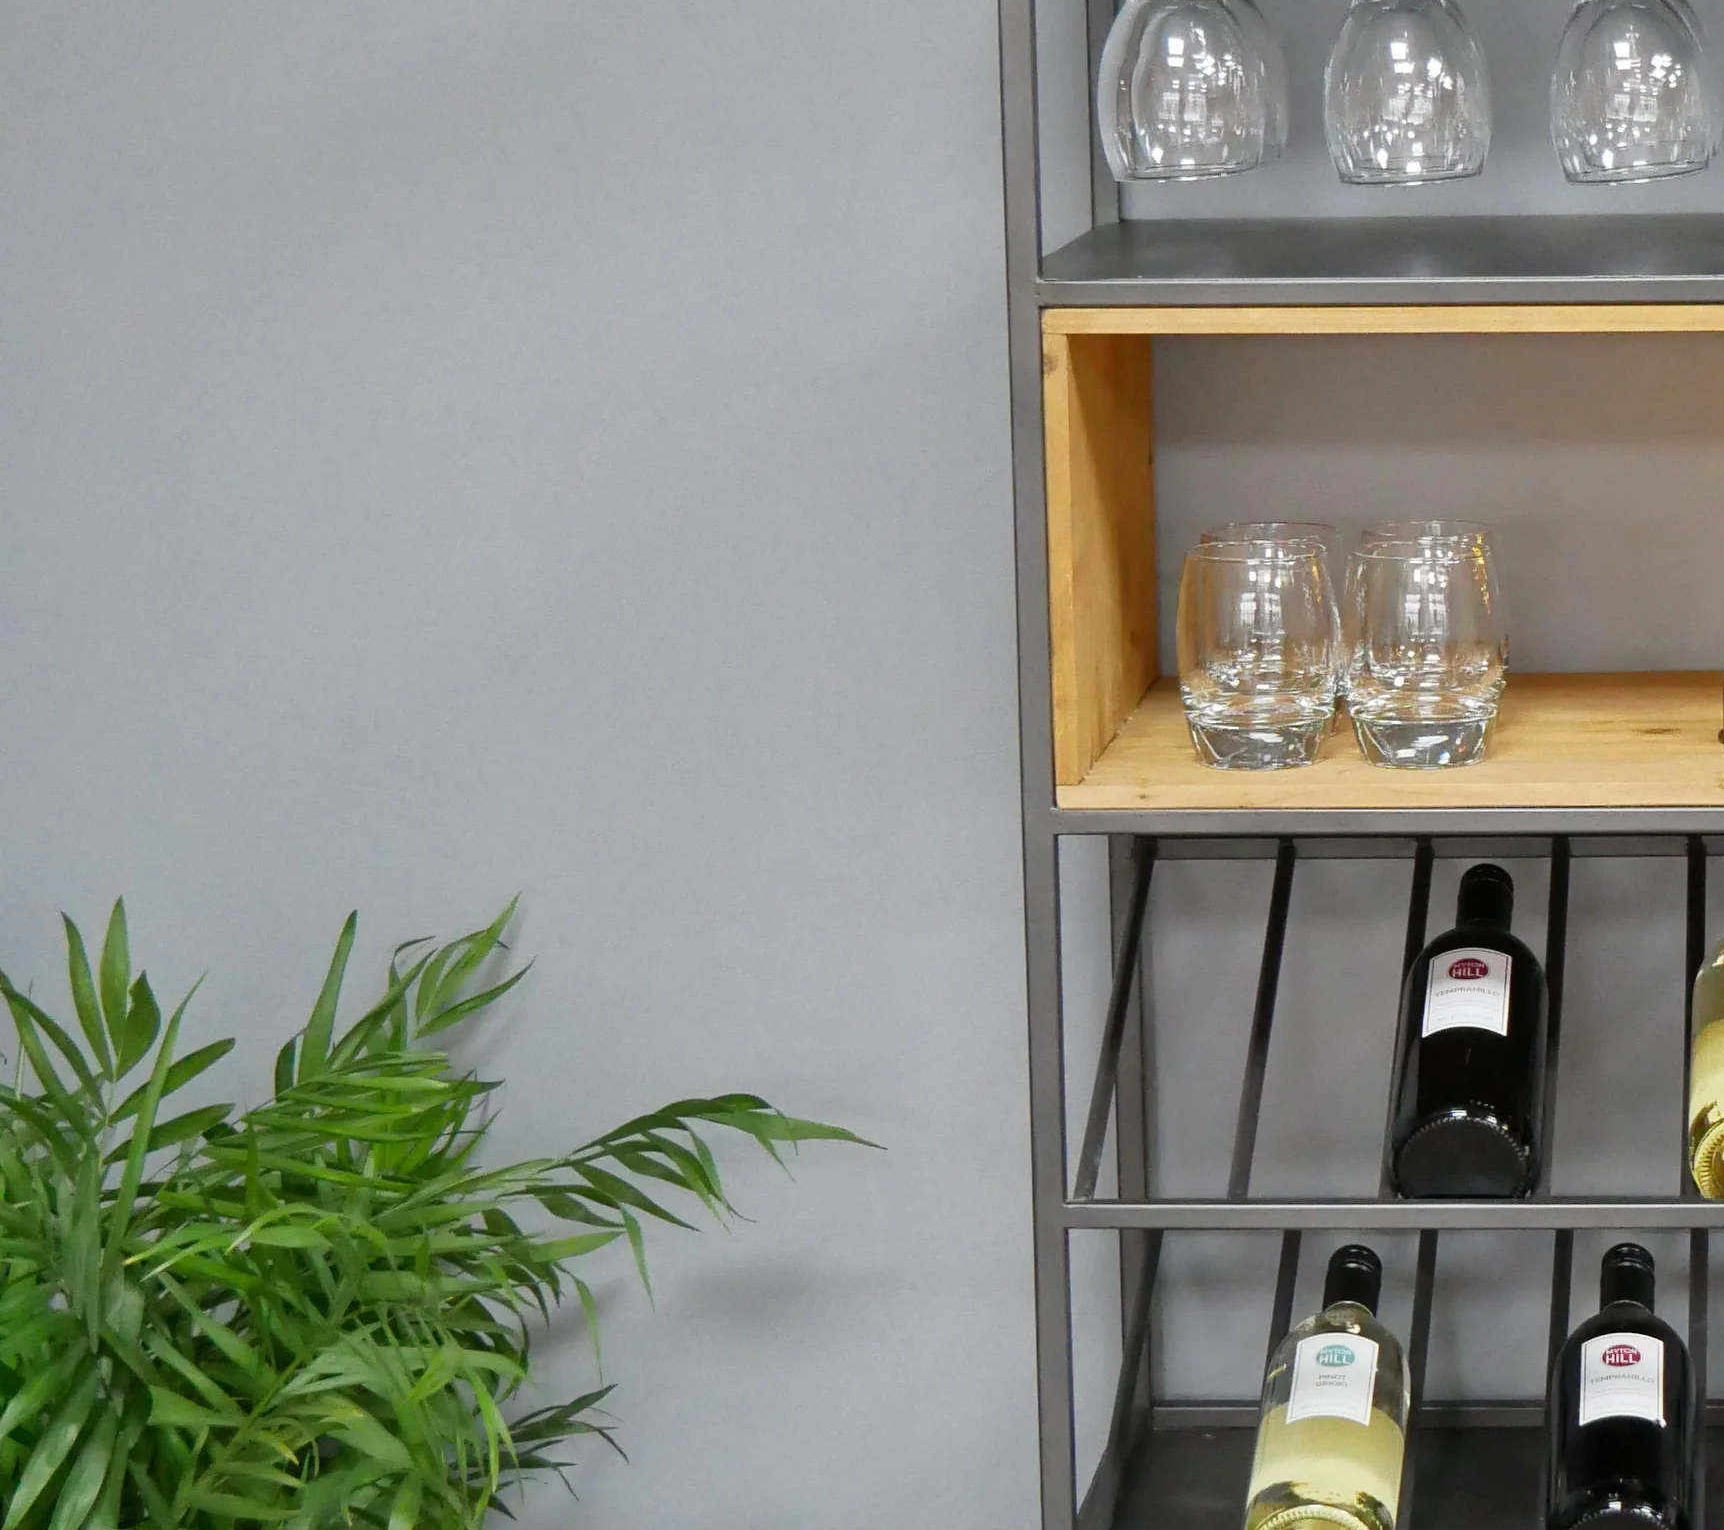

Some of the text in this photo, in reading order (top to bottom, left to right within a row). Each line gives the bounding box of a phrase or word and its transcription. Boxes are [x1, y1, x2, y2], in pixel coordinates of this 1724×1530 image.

[1452, 967, 1484, 978] HILL
[1319, 1353, 1351, 1365] HILL
[1605, 1353, 1638, 1365] HILL
